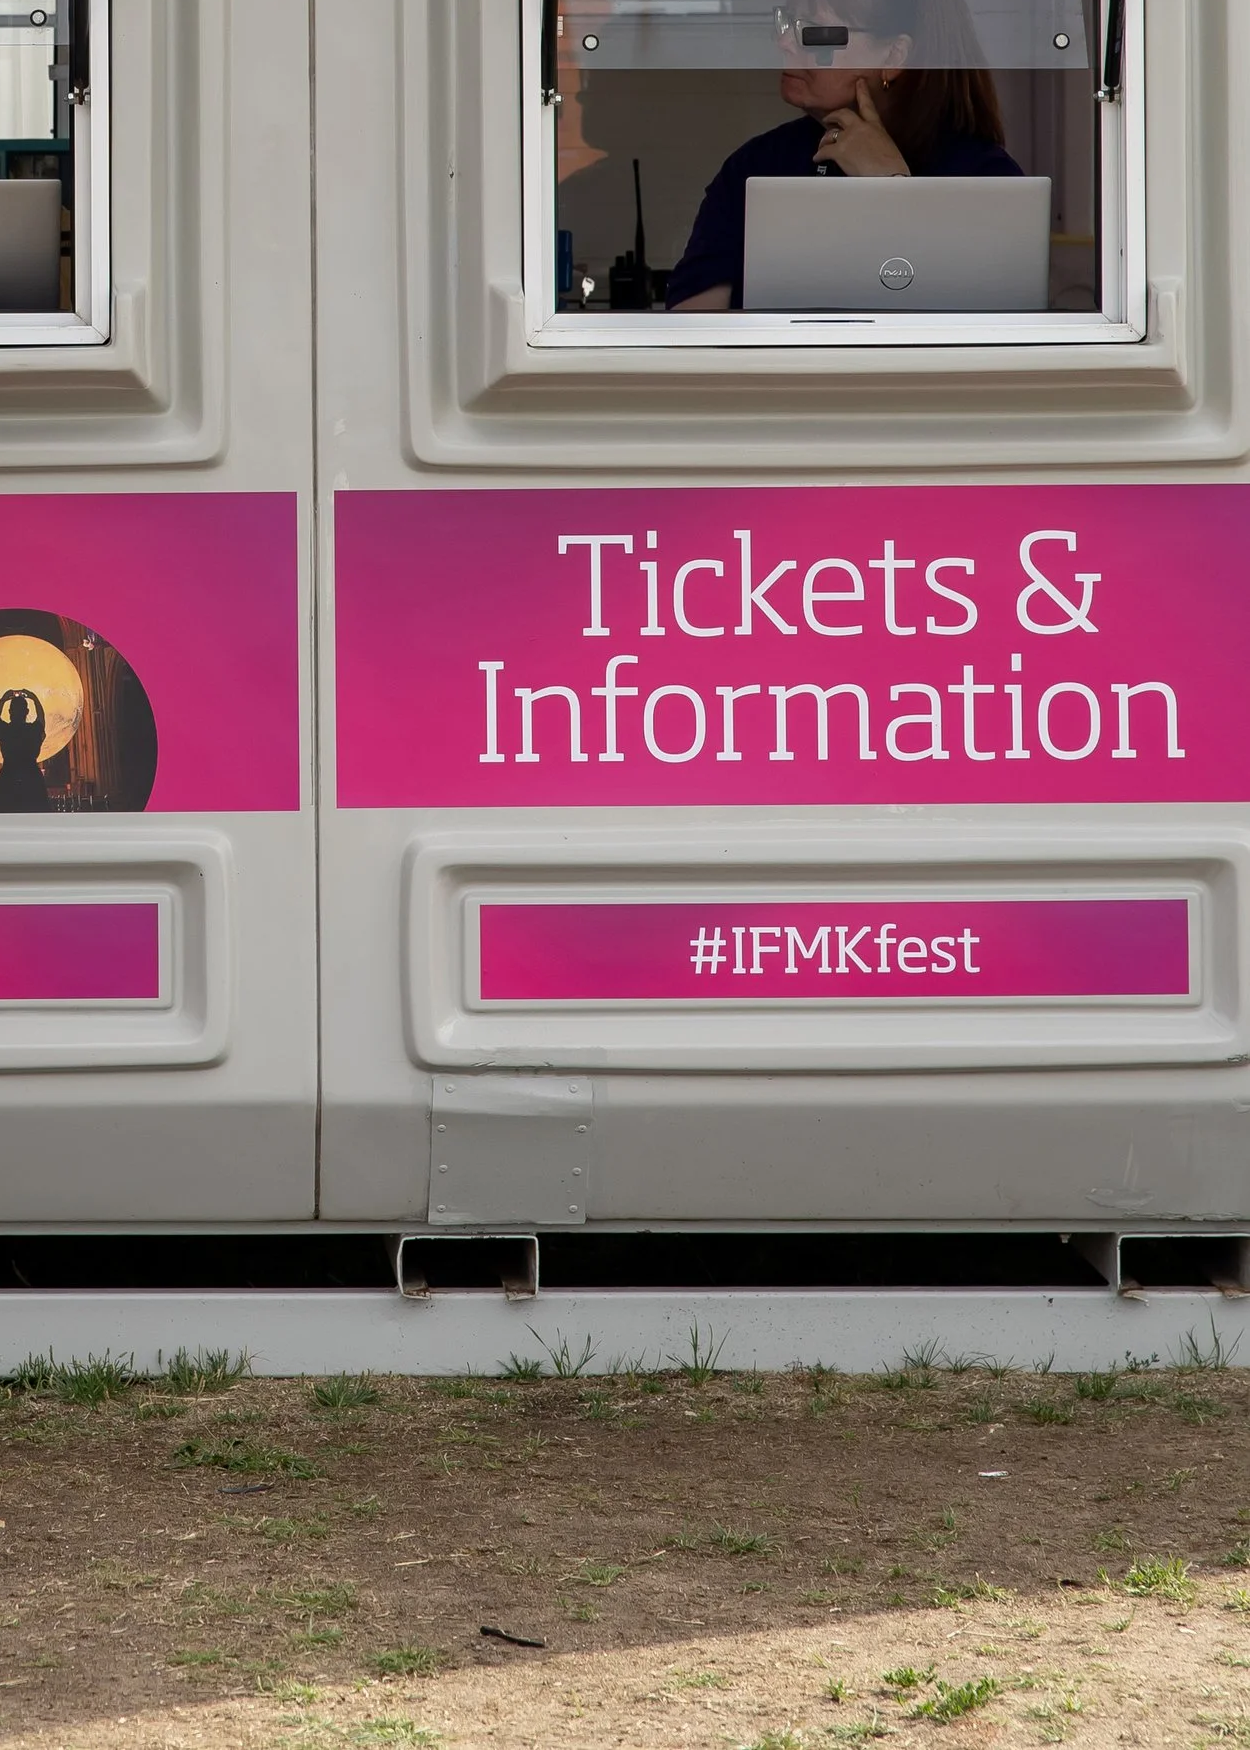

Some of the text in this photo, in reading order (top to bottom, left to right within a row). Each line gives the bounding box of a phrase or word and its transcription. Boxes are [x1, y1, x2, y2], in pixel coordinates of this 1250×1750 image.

[884, 269, 912, 278] DELL
[557, 529, 1102, 638] Tickets &
[478, 653, 1186, 764] Information
[689, 923, 981, 975] #IFMKfest
